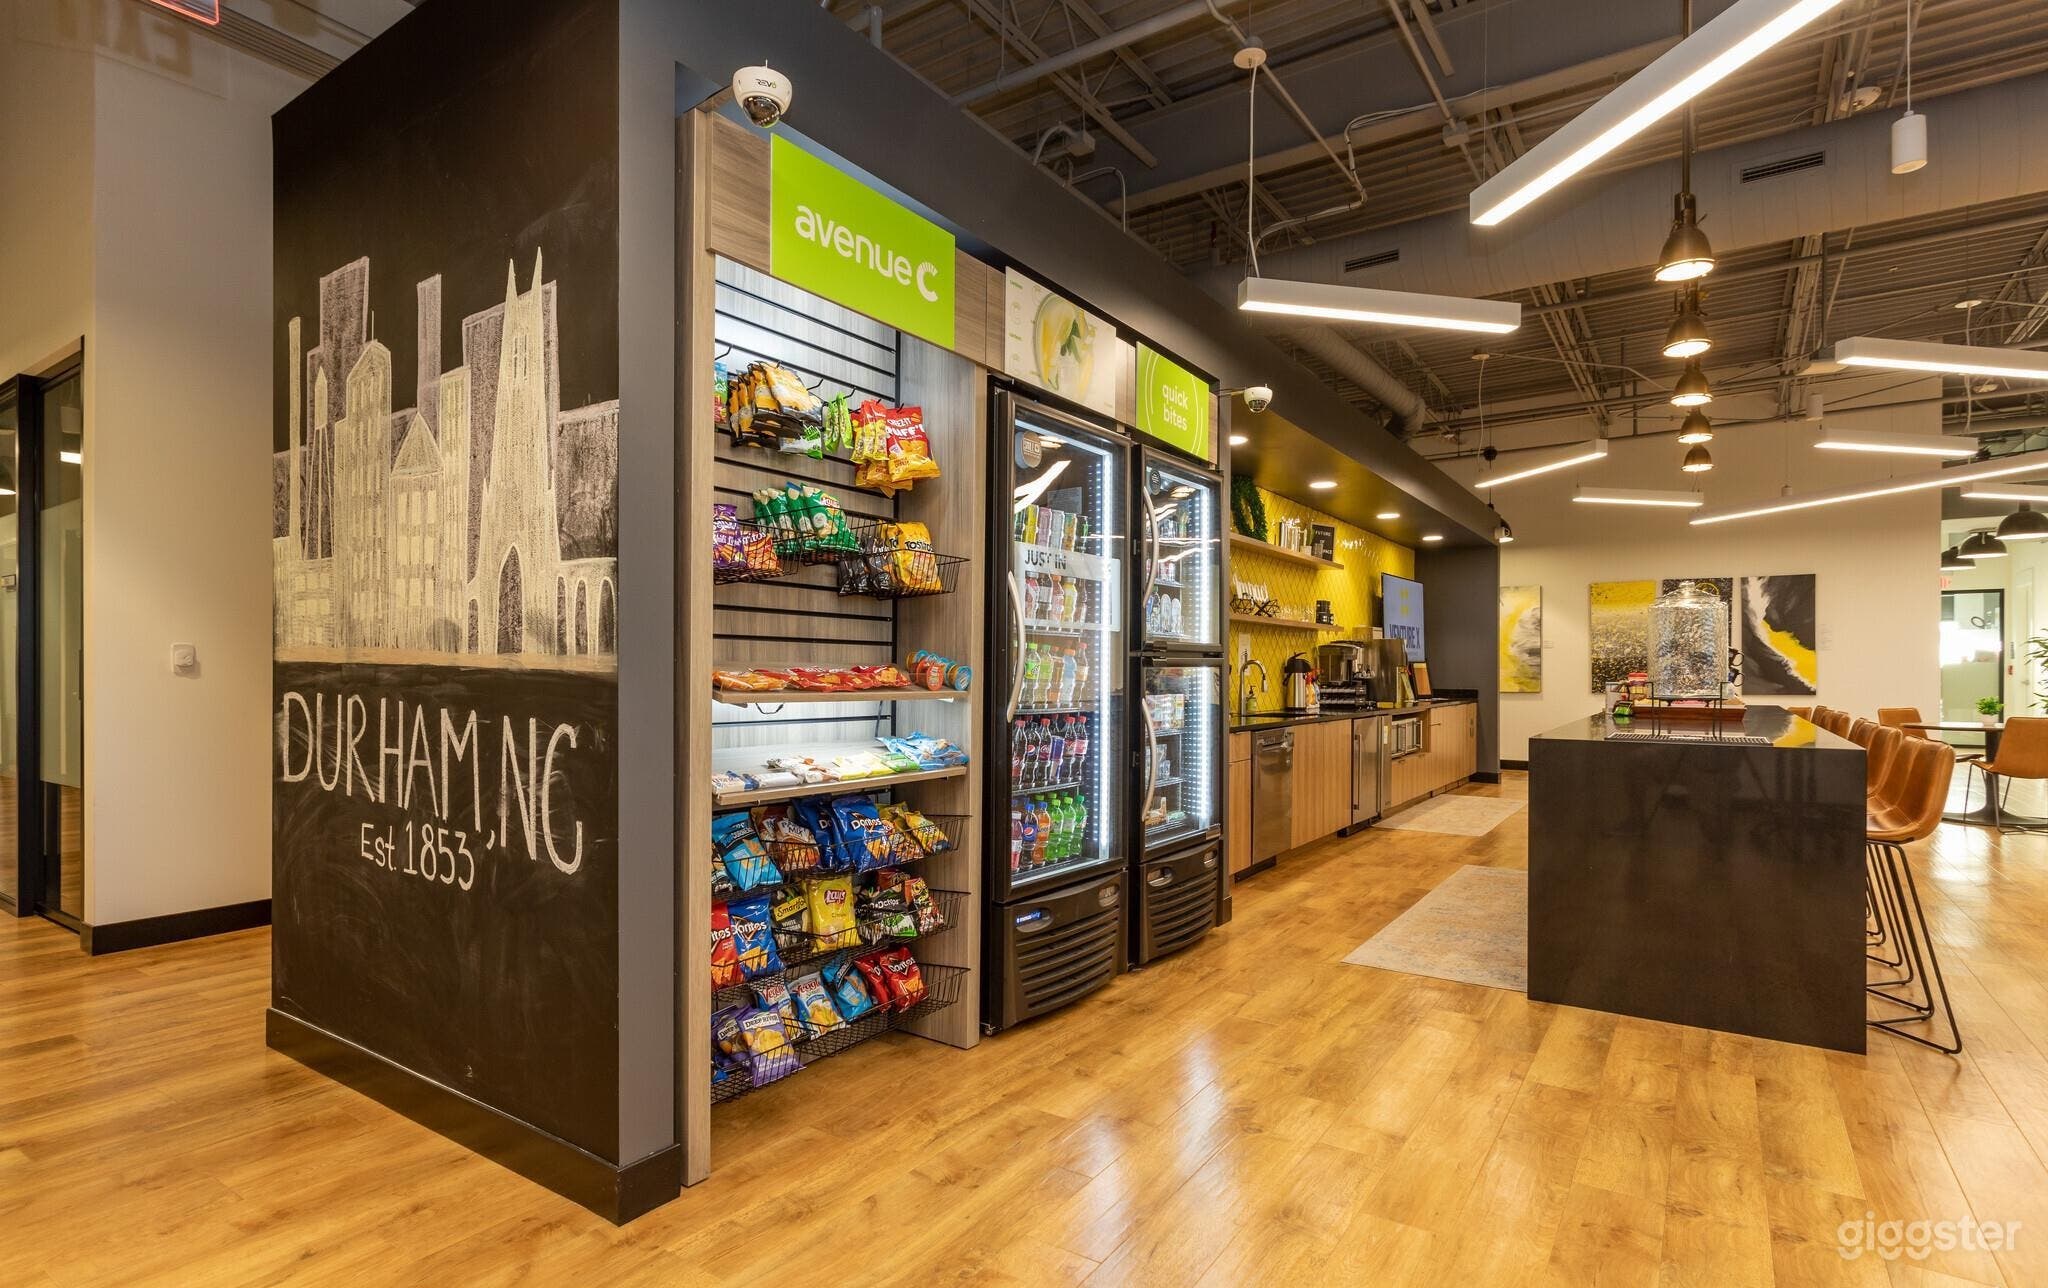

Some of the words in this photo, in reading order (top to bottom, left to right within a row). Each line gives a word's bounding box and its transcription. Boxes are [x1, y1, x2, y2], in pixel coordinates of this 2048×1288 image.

[795, 204, 912, 286] avenue
[916, 261, 939, 302] C
[1162, 384, 1188, 420] quick
[1163, 403, 1188, 431] bites
[904, 541, 935, 553] TOSTITOS
[1025, 549, 1051, 567] JUST
[1054, 554, 1067, 570] IN
[1389, 623, 1415, 648] VENTURE
[1415, 627, 1421, 649] X
[500, 714, 583, 875] NC
[851, 817, 882, 831] Doritos
[361, 822, 397, 871] Est.
[403, 820, 475, 891] 1853
[825, 890, 846, 904] Lay's
